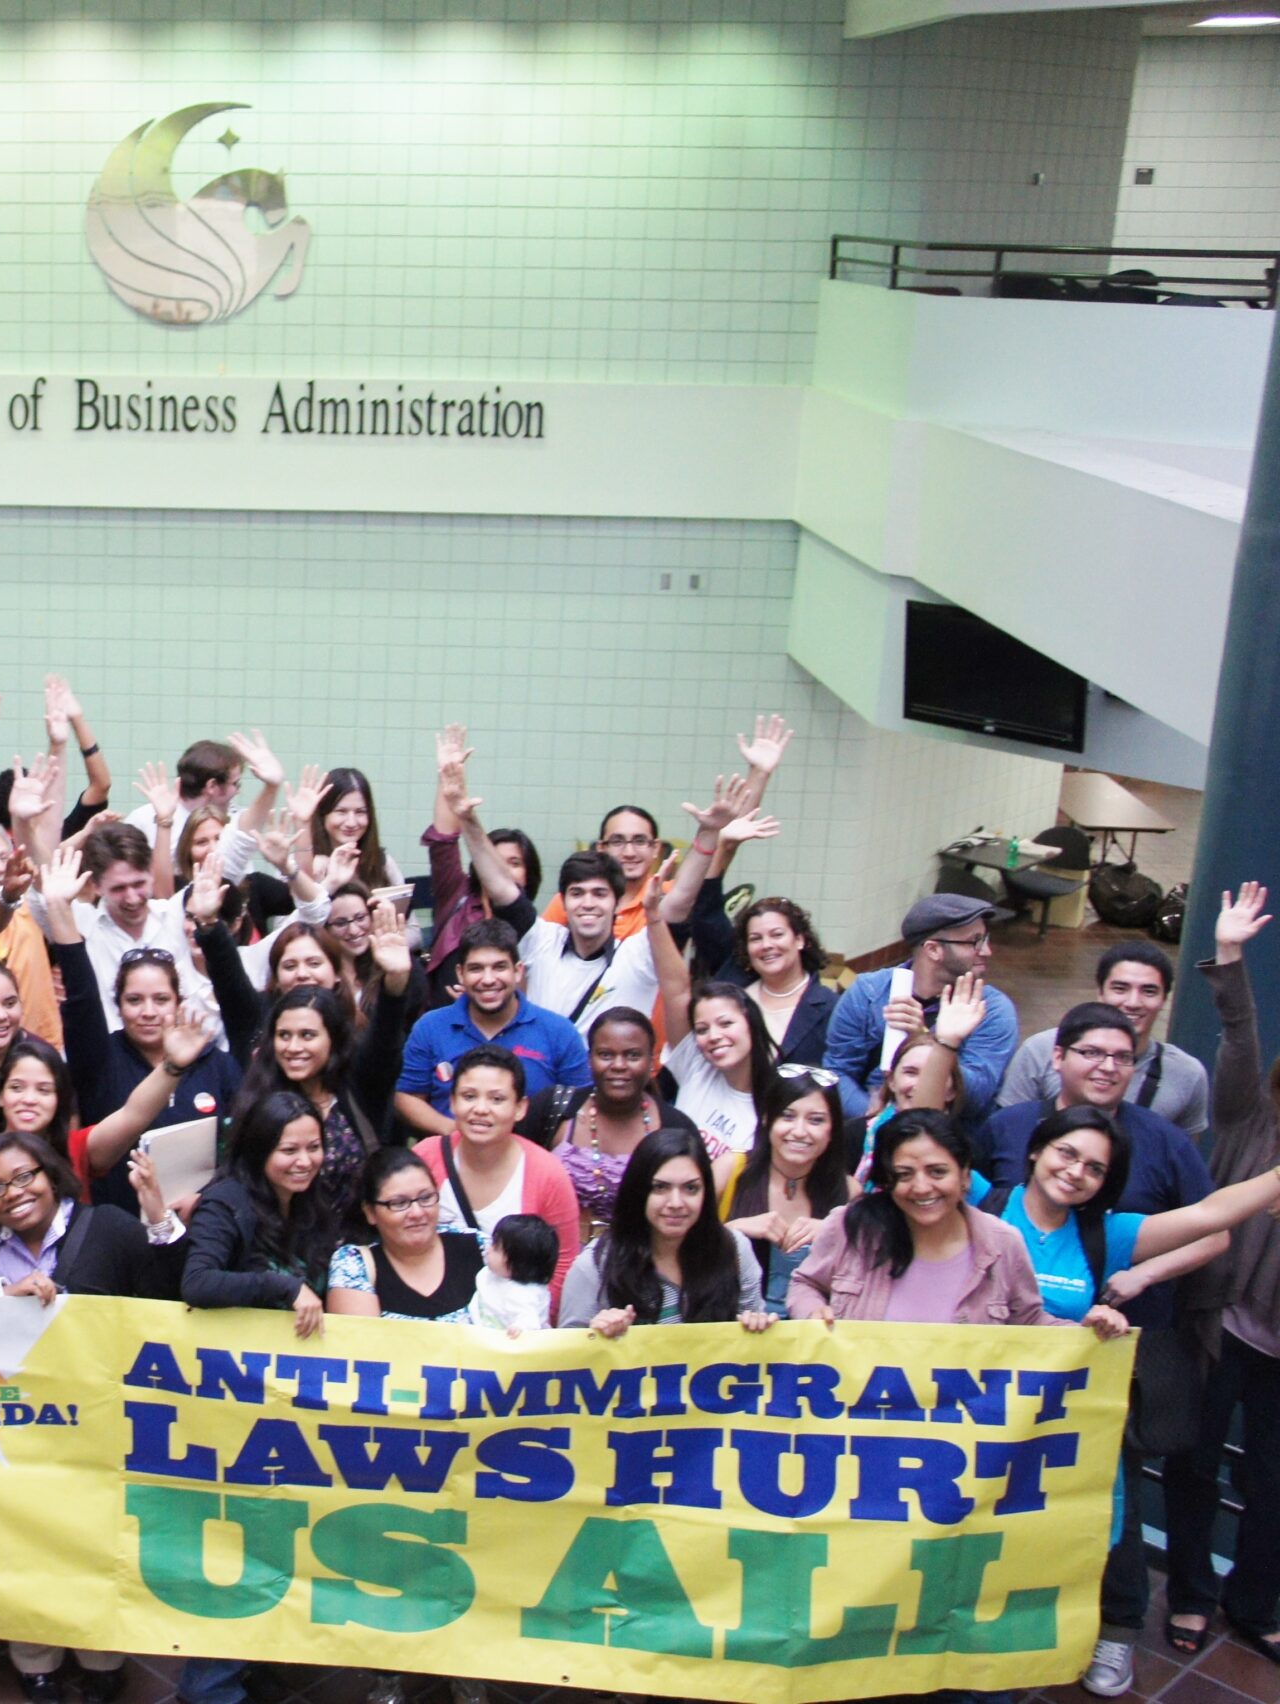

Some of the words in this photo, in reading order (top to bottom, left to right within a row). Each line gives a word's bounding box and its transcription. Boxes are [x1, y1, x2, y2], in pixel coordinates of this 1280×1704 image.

[7, 376, 47, 433] of
[73, 378, 238, 434] Business
[260, 380, 547, 440] Administration
[123, 1341, 1089, 1424] ANTI-IMMIGRANT
[124, 1401, 576, 1502] LAWS
[606, 1427, 1080, 1526] HURT
[124, 1484, 477, 1634] US
[520, 1516, 1061, 1669] ALL
